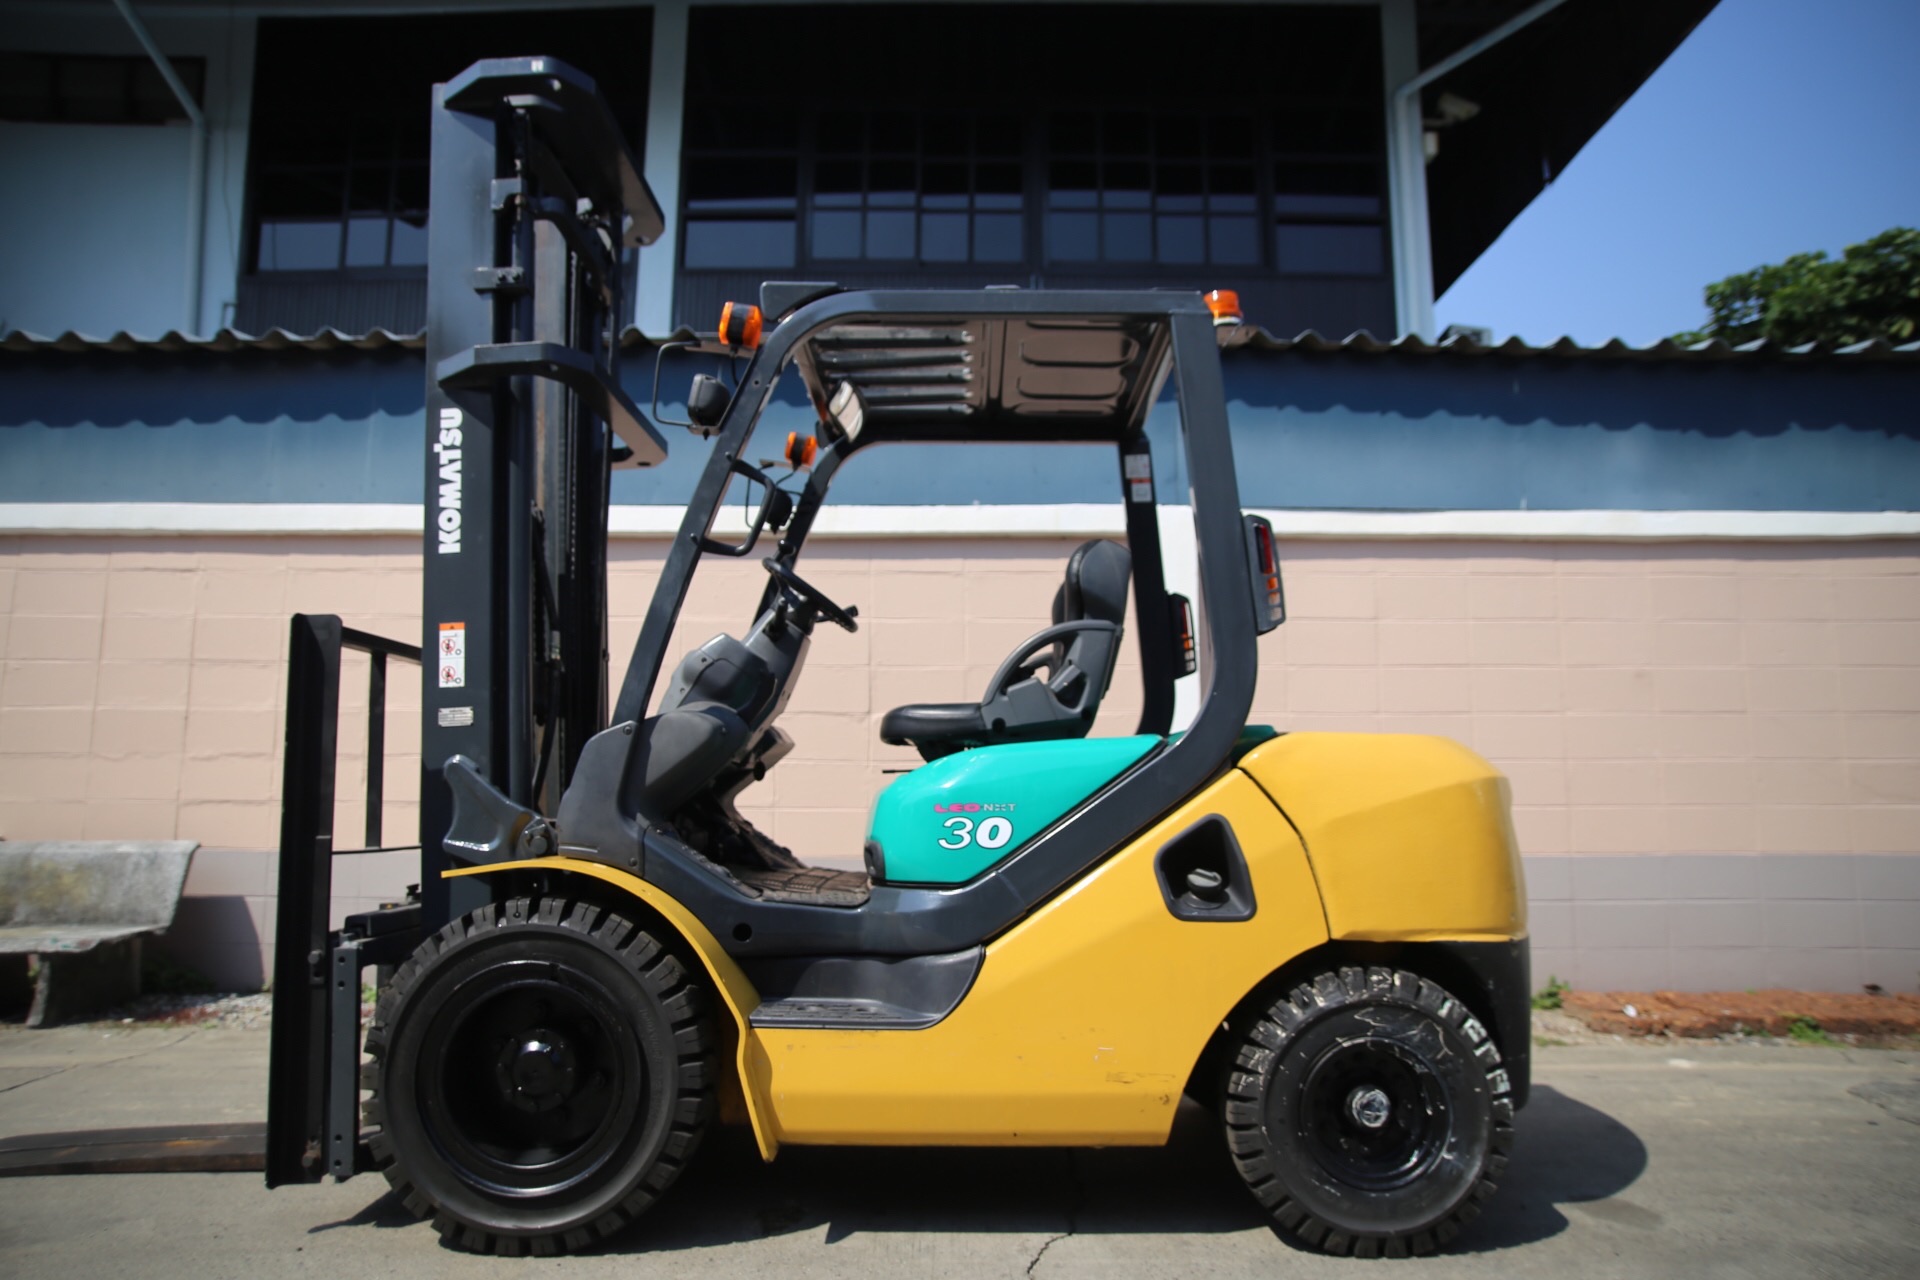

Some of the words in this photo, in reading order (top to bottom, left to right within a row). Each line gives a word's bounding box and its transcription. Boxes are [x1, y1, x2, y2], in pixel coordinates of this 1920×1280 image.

[433, 407, 463, 554] KOMATSU
[934, 802, 980, 813] LEO
[937, 815, 1014, 850] 30
